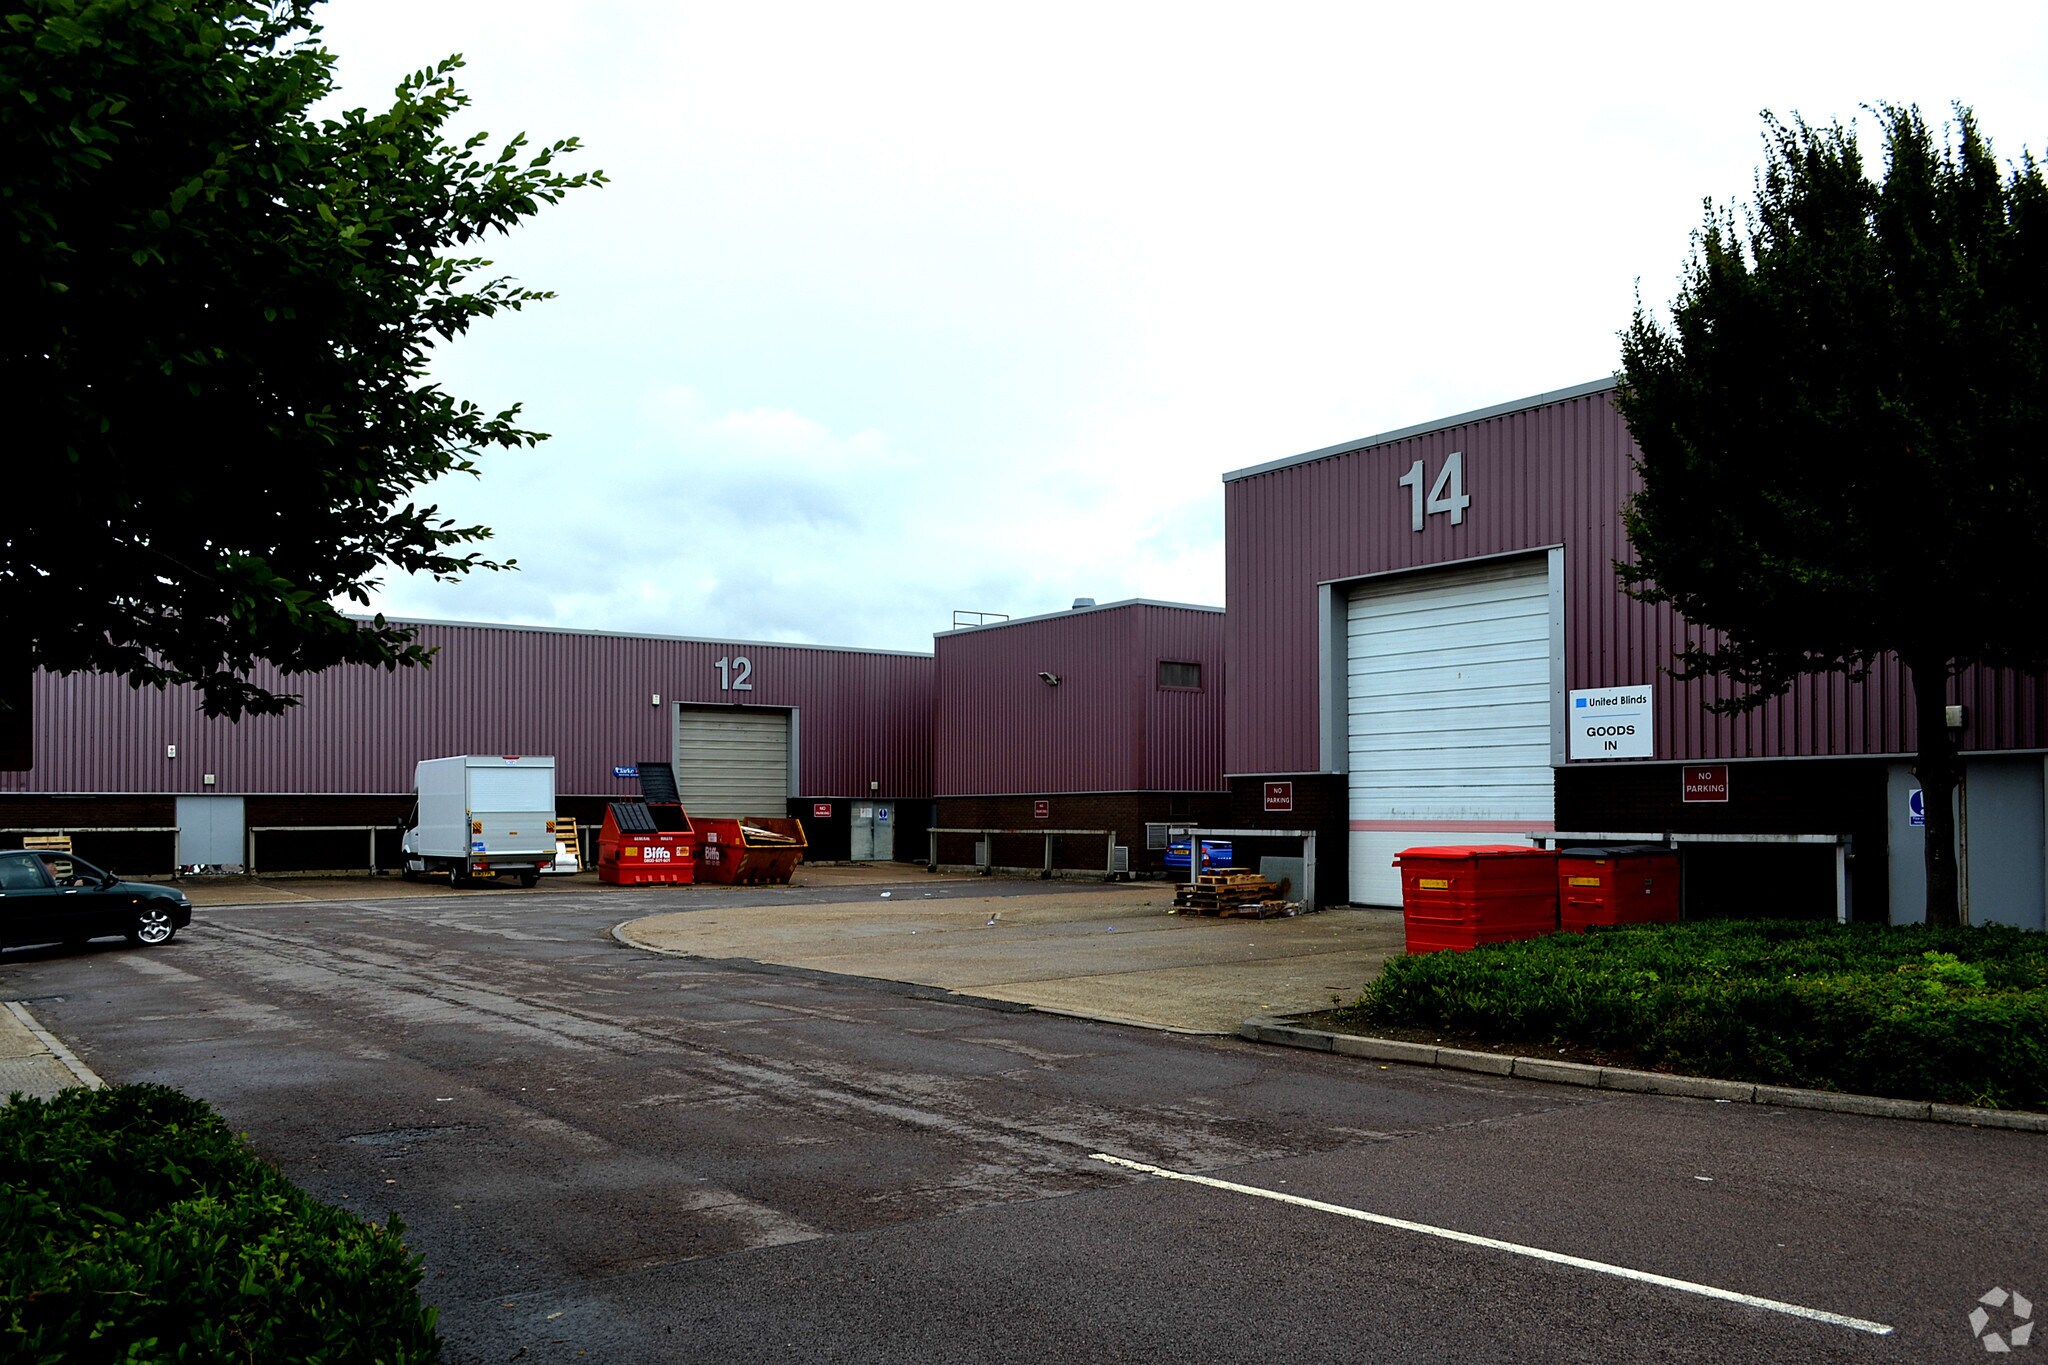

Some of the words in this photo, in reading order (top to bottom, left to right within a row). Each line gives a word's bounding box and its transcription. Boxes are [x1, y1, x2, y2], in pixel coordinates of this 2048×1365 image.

[1399, 452, 1470, 532] 14
[714, 656, 752, 690] 12
[1589, 696, 1618, 707] United
[1620, 694, 1647, 705] Blinds
[1586, 725, 1636, 737] GOODS
[1604, 740, 1617, 751] IN
[1698, 772, 1712, 780] NO
[1686, 784, 1725, 793] PARKING
[643, 846, 671, 859] Biffa
